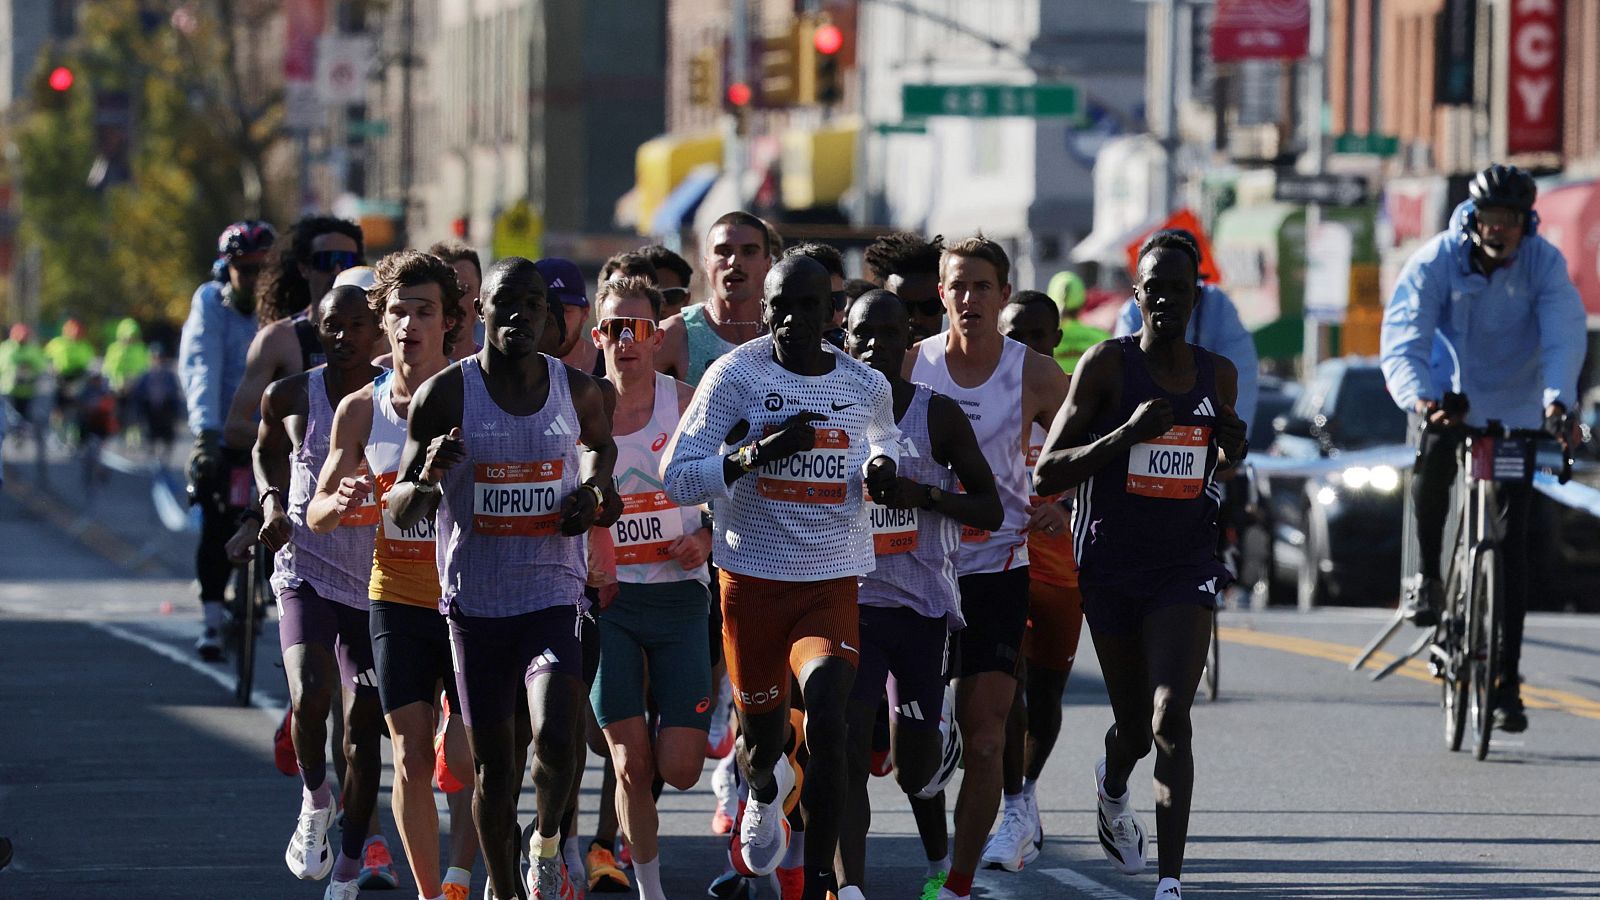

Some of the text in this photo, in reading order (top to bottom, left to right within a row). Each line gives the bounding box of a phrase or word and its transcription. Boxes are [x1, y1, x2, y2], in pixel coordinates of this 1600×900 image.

[486, 466, 506, 479] tcs
[1148, 450, 1194, 476] KORIR
[482, 486, 555, 513] KIPRUTO
[616, 516, 663, 544] BOUR
[889, 536, 913, 548] 2025
